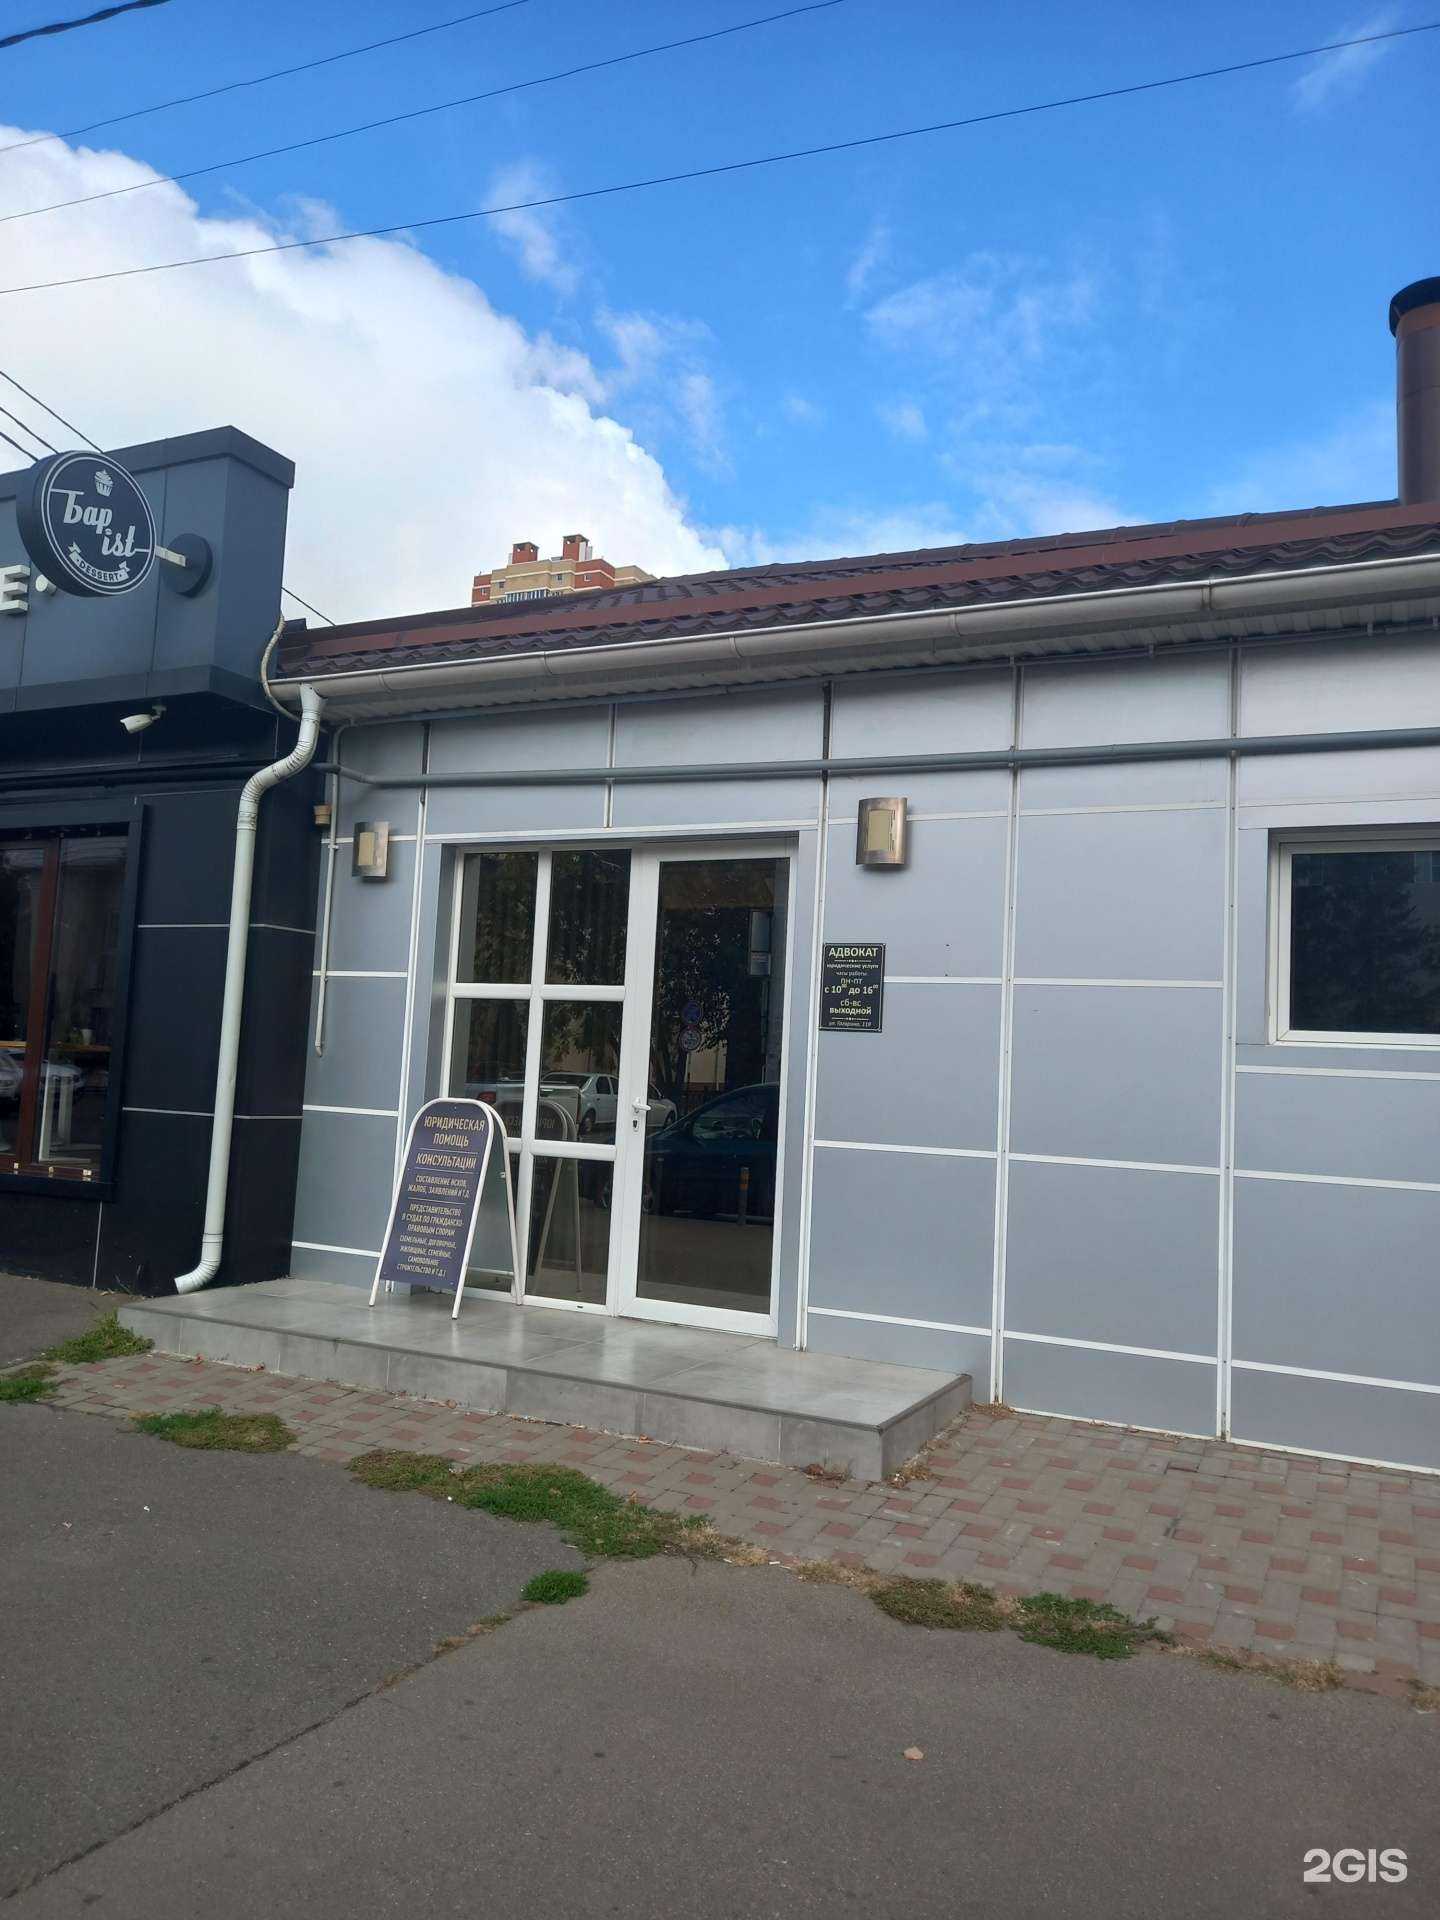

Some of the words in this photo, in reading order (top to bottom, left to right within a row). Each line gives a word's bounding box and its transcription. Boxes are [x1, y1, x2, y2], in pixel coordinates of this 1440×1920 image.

[79, 562, 120, 582] DESSERT
[828, 947, 879, 959] АДВОКАТ
[848, 987, 861, 996] до
[840, 998, 862, 1007] сб-вс
[829, 1006, 872, 1016] выходной
[423, 1115, 485, 1132] ЮРИДИЧЕСКАЯ
[432, 1133, 470, 1147] ПОМОЩЬ
[415, 1152, 477, 1170] КОНСУЛЬТАЦИИ
[415, 1174, 450, 1185] СОСТАВЛЕНИЕ
[407, 1184, 427, 1194] ЖАЛОБ,
[409, 1203, 462, 1217] ПРЕДСТАВИТЕЛЬСТВО
[406, 1213, 422, 1223] СУДАХ
[421, 1215, 430, 1224] ПО
[407, 1223, 435, 1235] ПРАВОВЫМ
[435, 1227, 456, 1237] СПОРАМ
